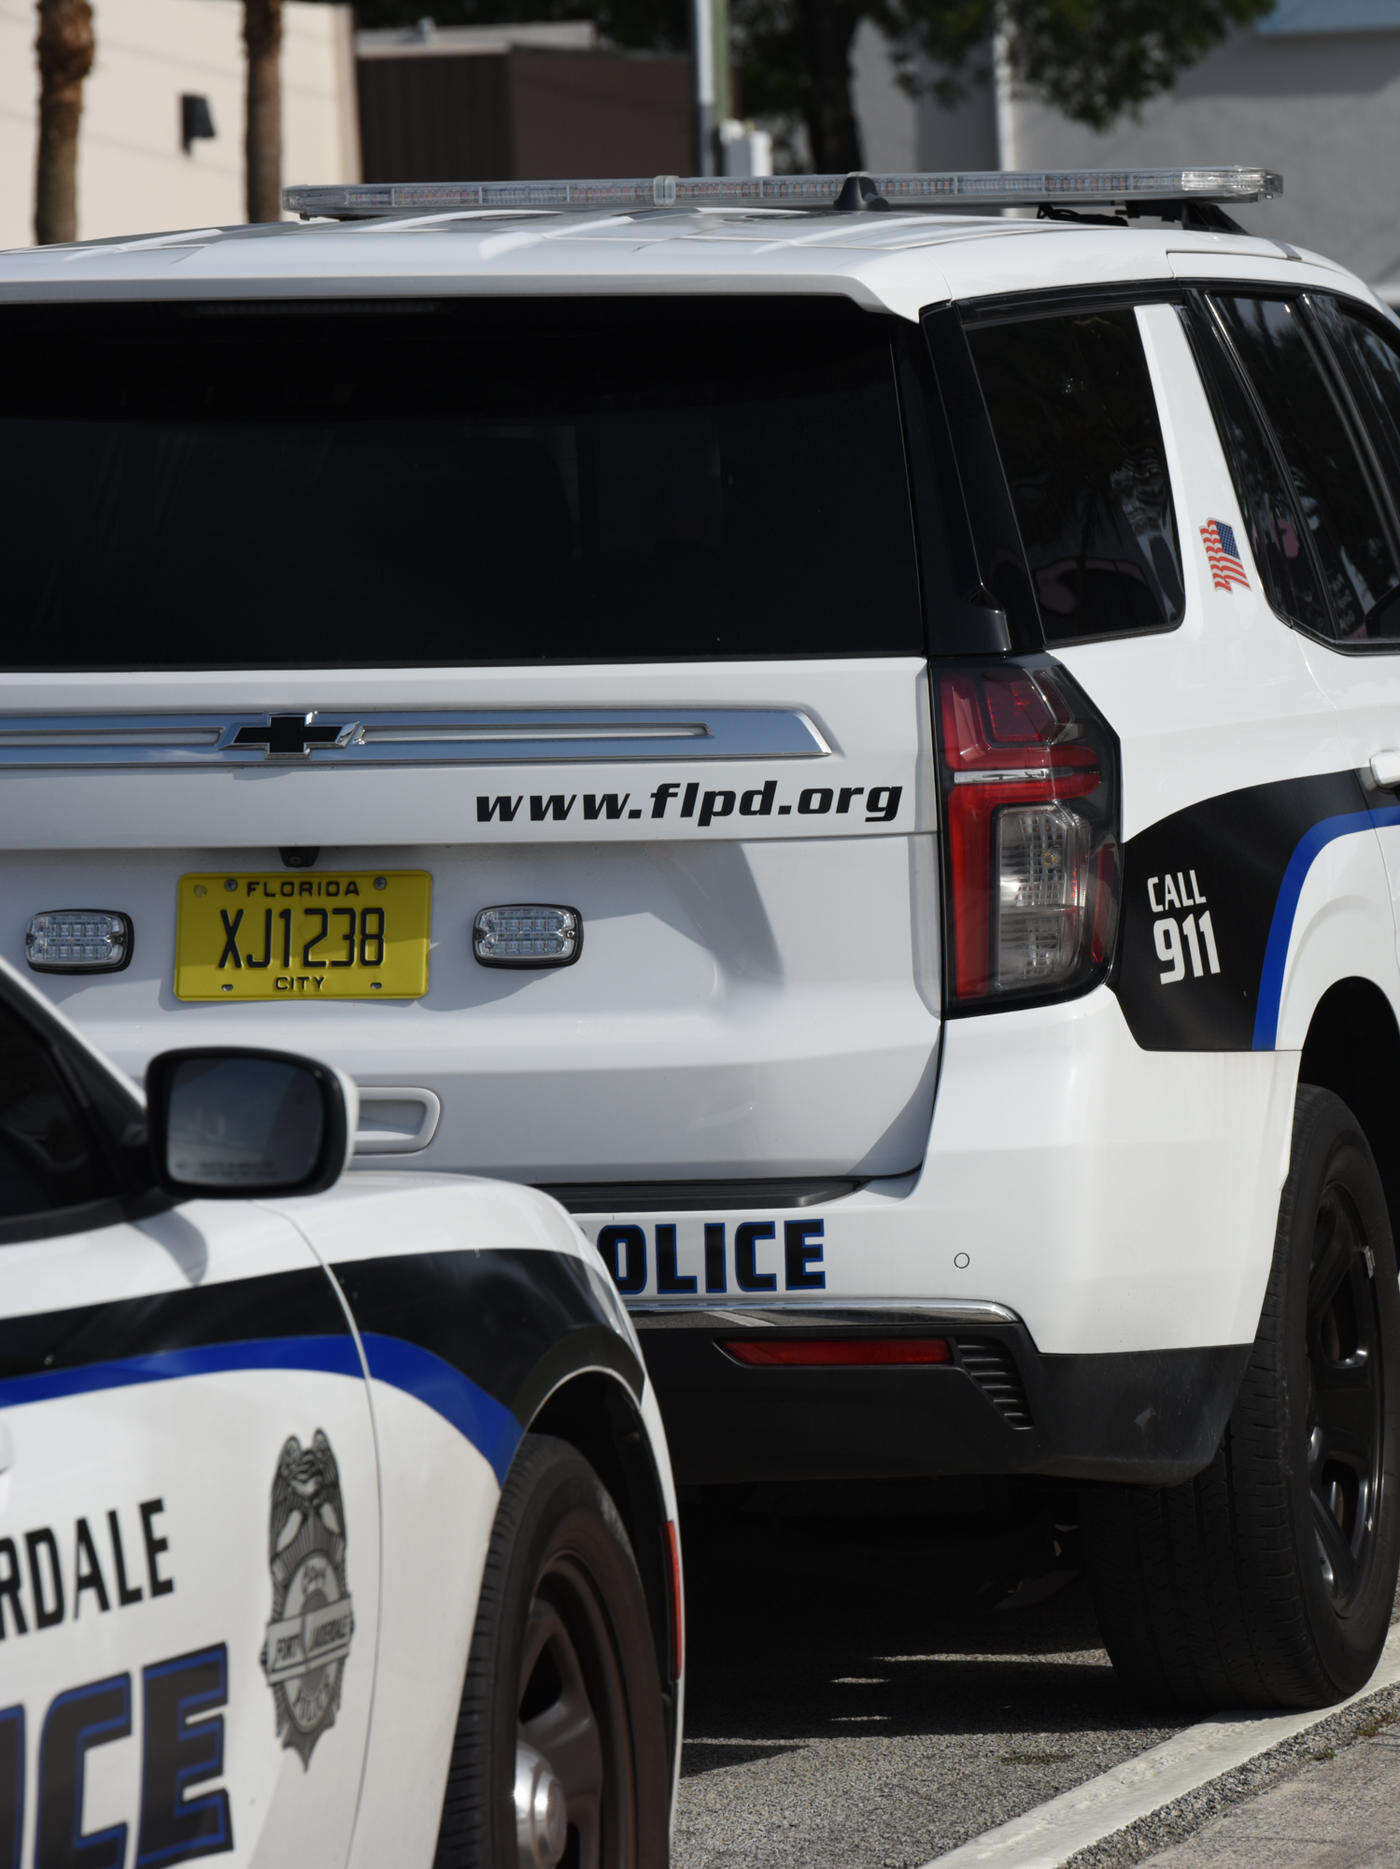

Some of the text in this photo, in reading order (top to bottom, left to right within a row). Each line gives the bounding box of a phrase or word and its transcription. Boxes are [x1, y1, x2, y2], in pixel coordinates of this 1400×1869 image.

[476, 780, 903, 827] www.flpd.org
[247, 880, 360, 898] FLORIDA
[1147, 869, 1207, 913] CALL
[218, 907, 386, 969] XJ1238
[1153, 910, 1221, 985] 911
[275, 976, 326, 991] CITY
[580, 1219, 826, 1295] OLICE
